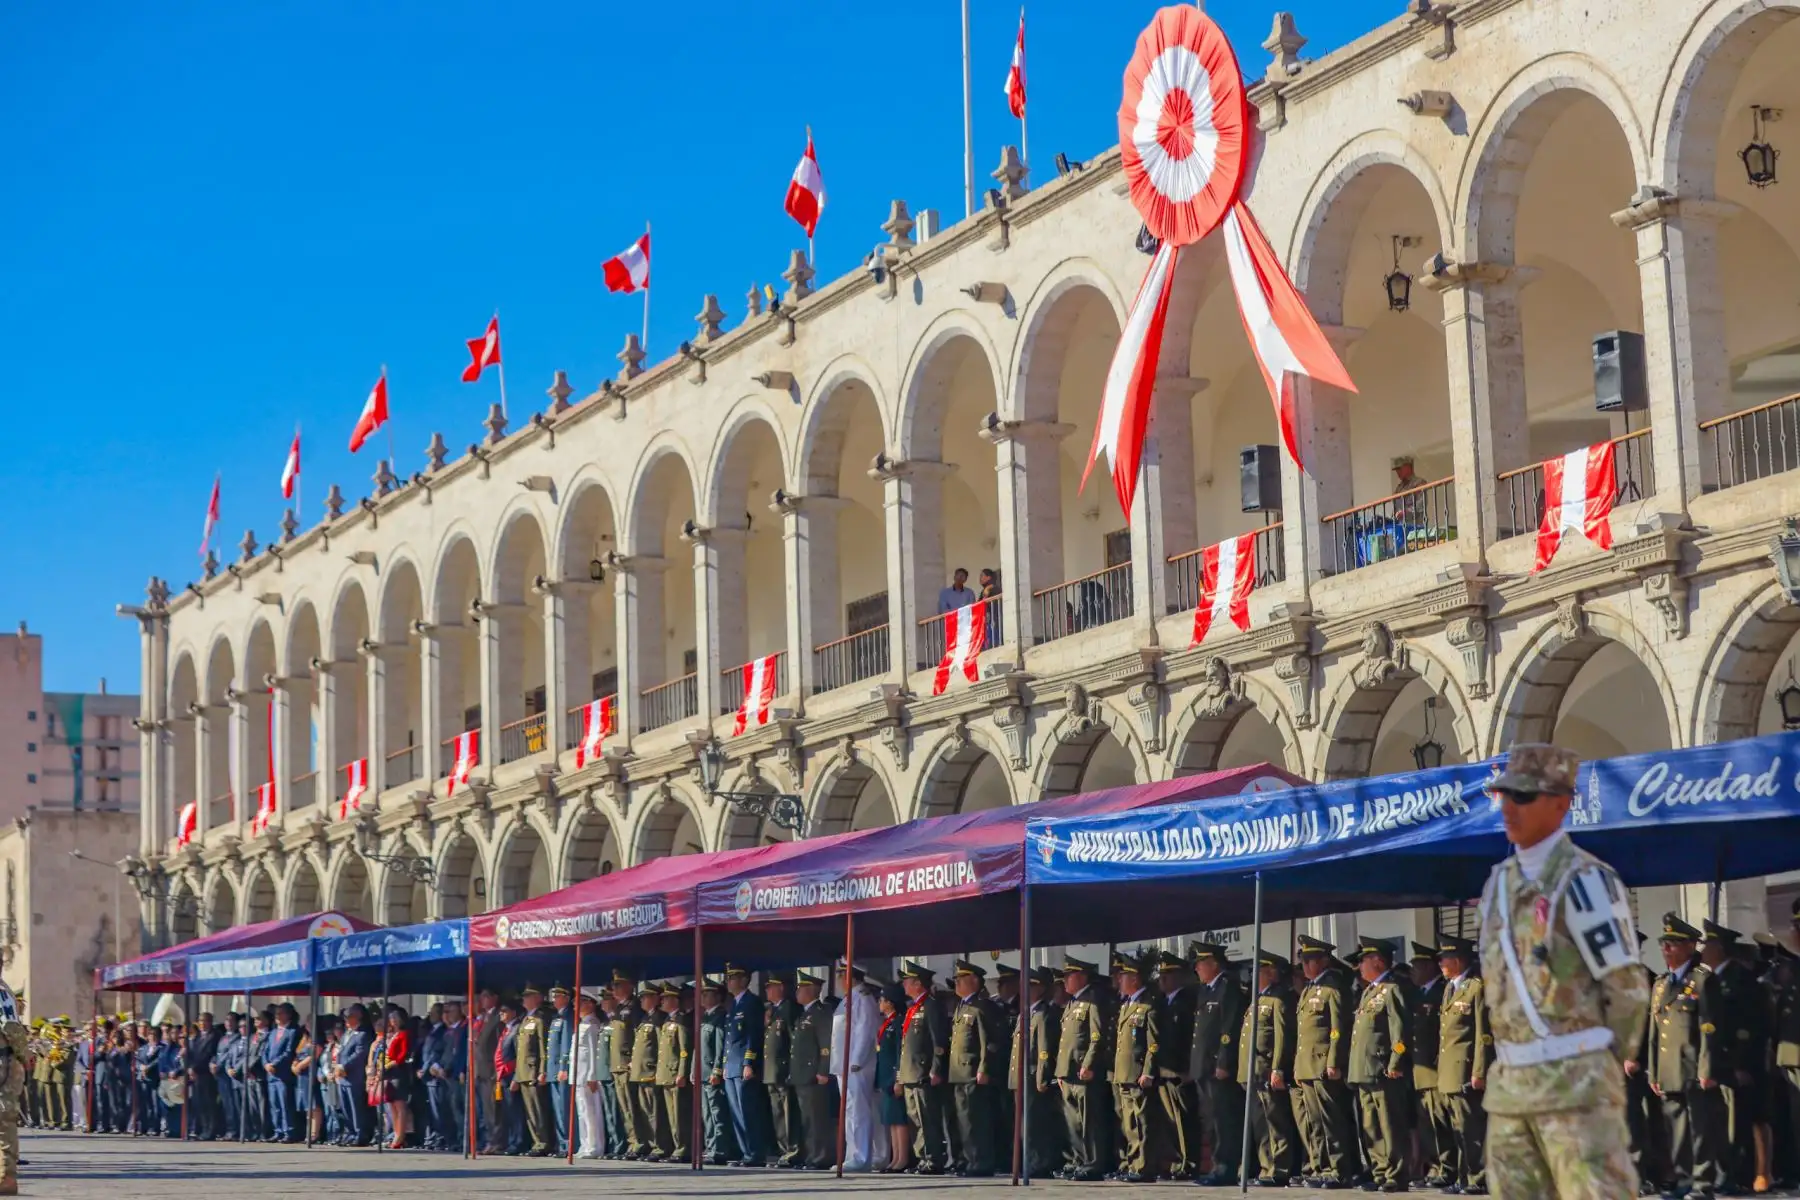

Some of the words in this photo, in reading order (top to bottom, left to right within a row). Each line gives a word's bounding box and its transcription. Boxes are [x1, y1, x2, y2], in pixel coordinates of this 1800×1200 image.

[1628, 756, 1781, 817] Ciudad
[1067, 826, 1206, 862] MUNICIPALIDAD
[1208, 810, 1322, 858] PROVINCIAL
[1325, 803, 1355, 842] DE
[1355, 780, 1470, 836] AREQUIPA
[755, 883, 817, 909] GOBIERNO
[818, 878, 883, 904] REGIONAL
[885, 871, 905, 895] DE
[907, 860, 977, 892] AREQUIPA
[510, 919, 554, 939] GOBIERNO
[555, 913, 600, 935] REGIONAL
[602, 910, 615, 930] DE
[617, 902, 664, 927] AREQUIPA
